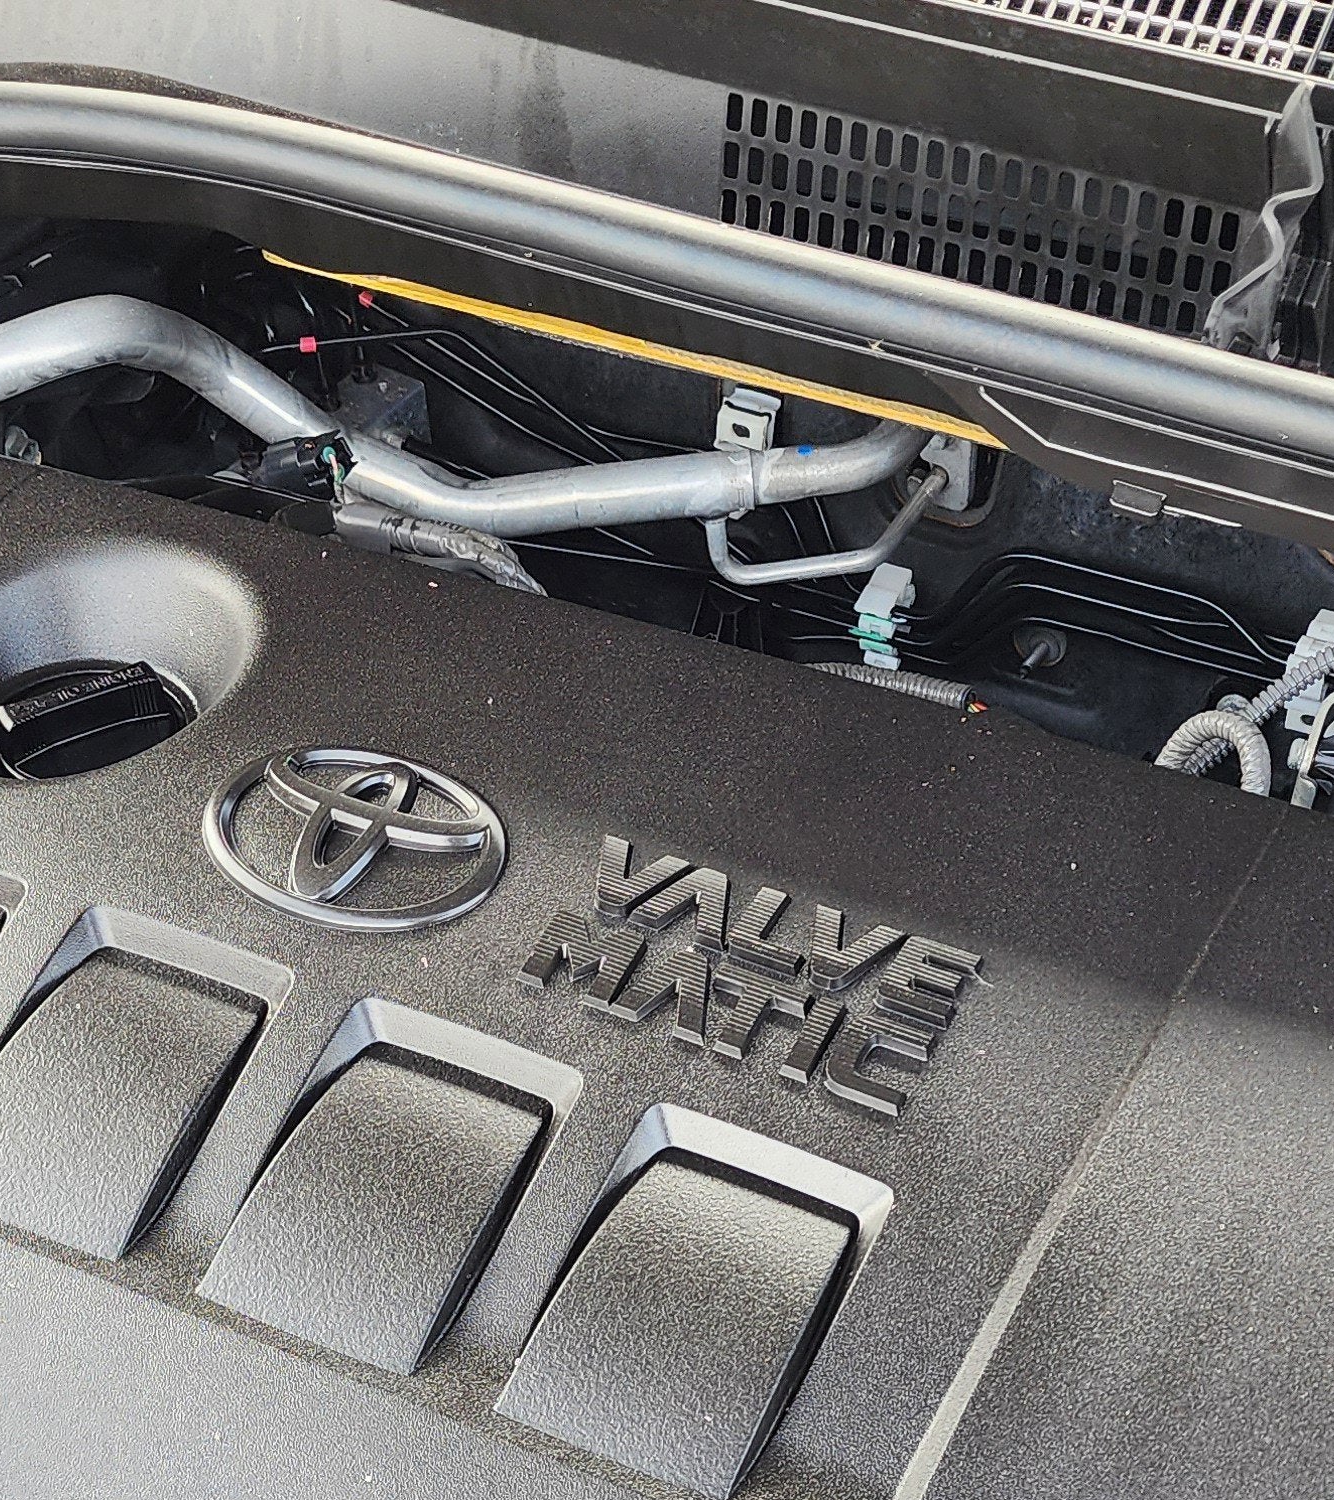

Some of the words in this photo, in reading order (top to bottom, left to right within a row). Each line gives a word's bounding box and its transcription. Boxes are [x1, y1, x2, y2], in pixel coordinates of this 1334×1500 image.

[81, 663, 145, 693] ENGINE
[517, 909, 939, 1118] MATIC
[594, 834, 984, 1029] VALVE
